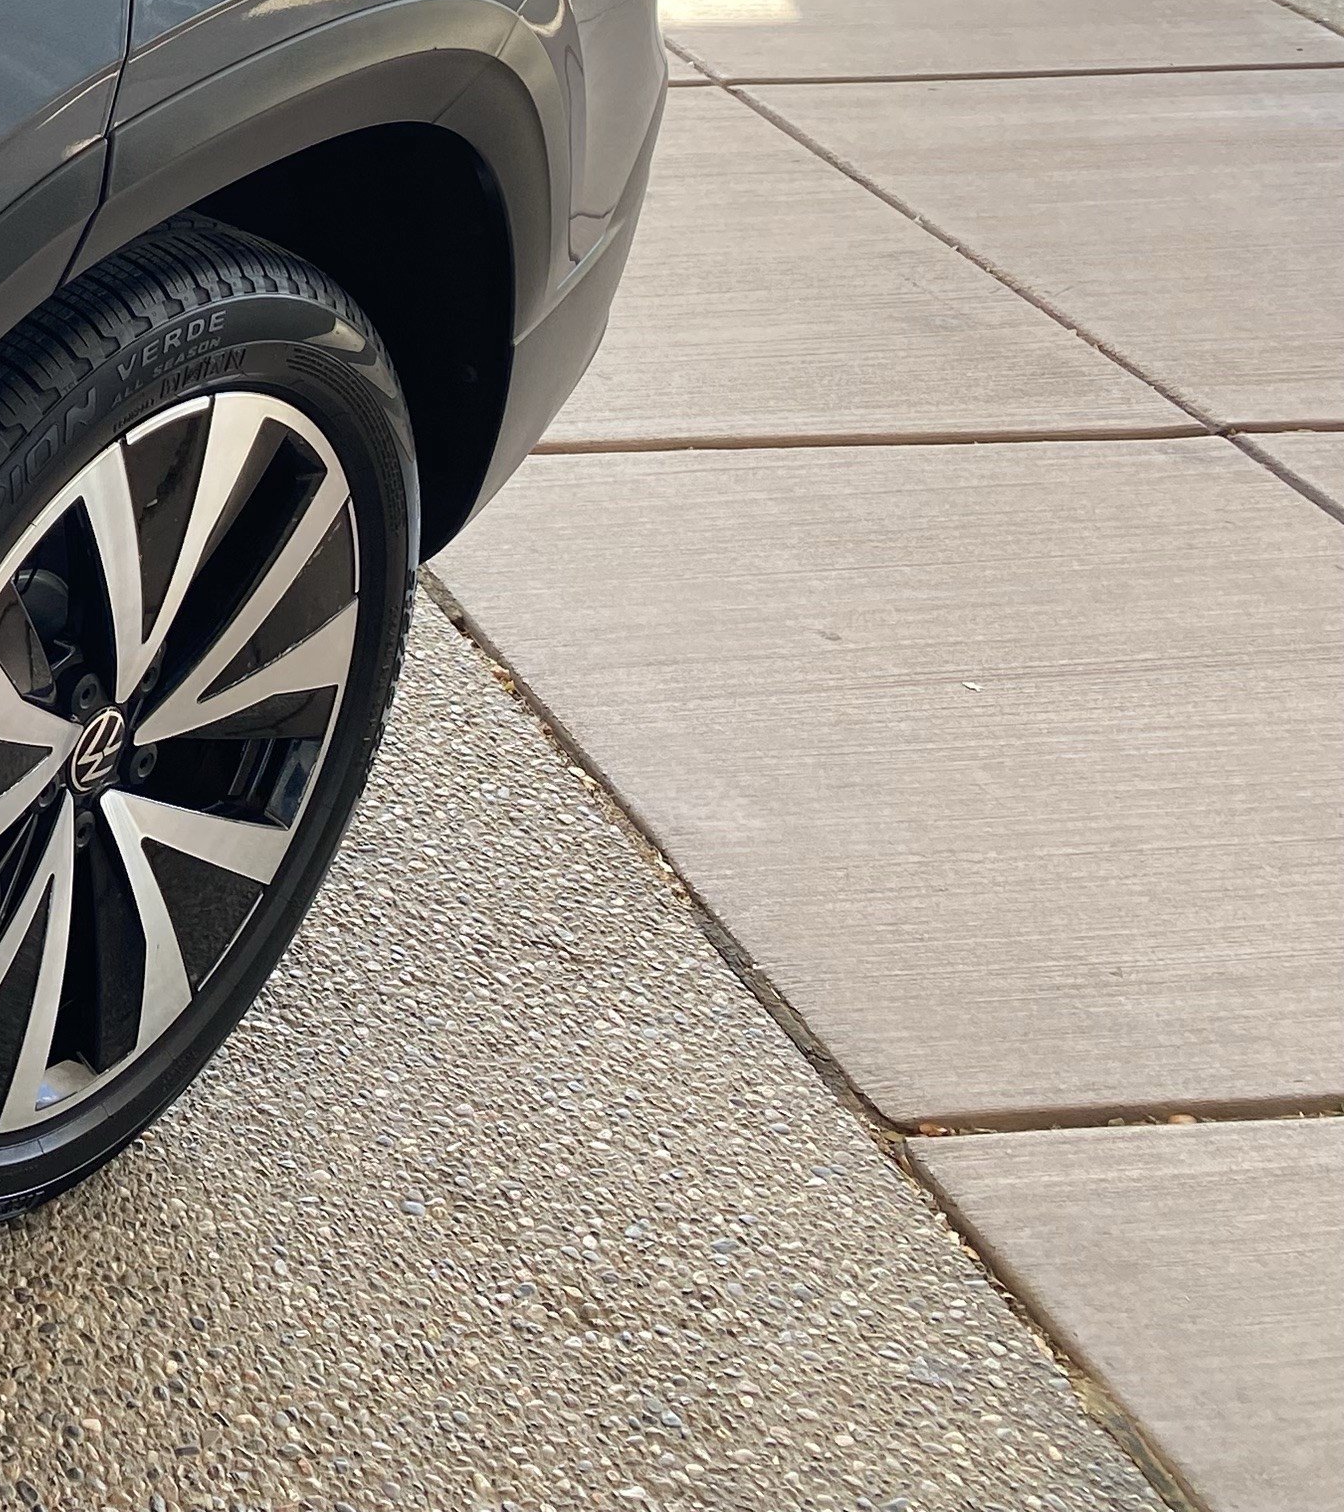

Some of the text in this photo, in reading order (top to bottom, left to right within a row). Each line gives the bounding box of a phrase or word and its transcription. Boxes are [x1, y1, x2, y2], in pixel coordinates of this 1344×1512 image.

[112, 378, 144, 408] ALL
[153, 336, 222, 377] SEASON
[116, 310, 227, 381] VERDE
